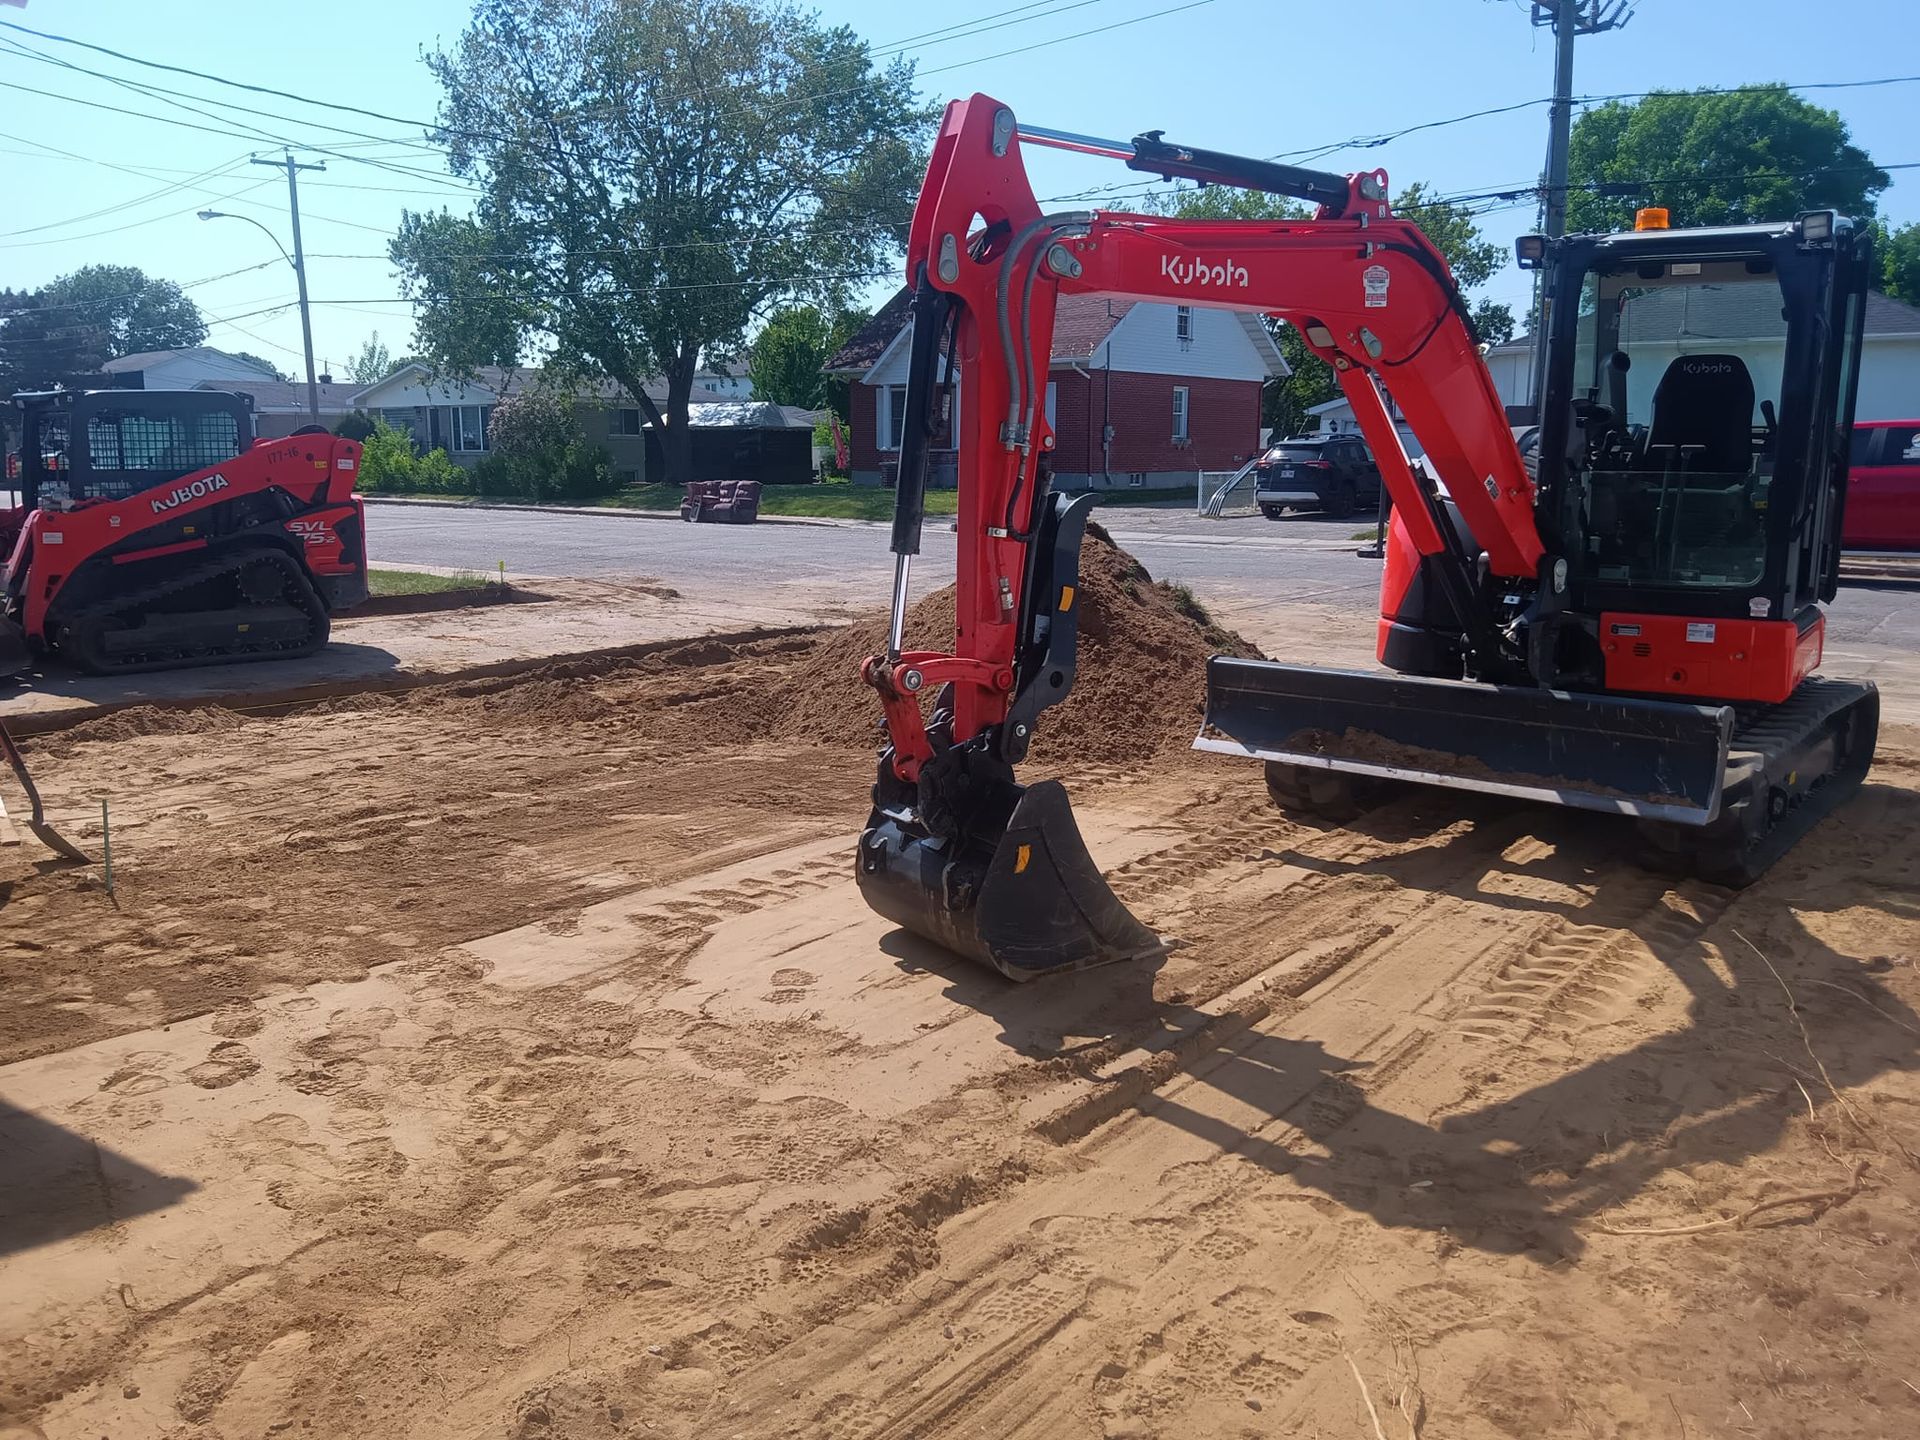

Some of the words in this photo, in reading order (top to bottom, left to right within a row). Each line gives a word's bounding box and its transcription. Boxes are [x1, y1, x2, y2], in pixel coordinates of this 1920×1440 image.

[1161, 255, 1249, 287] Kubota
[1683, 362, 1732, 375] Kubota
[289, 521, 332, 532] SVL
